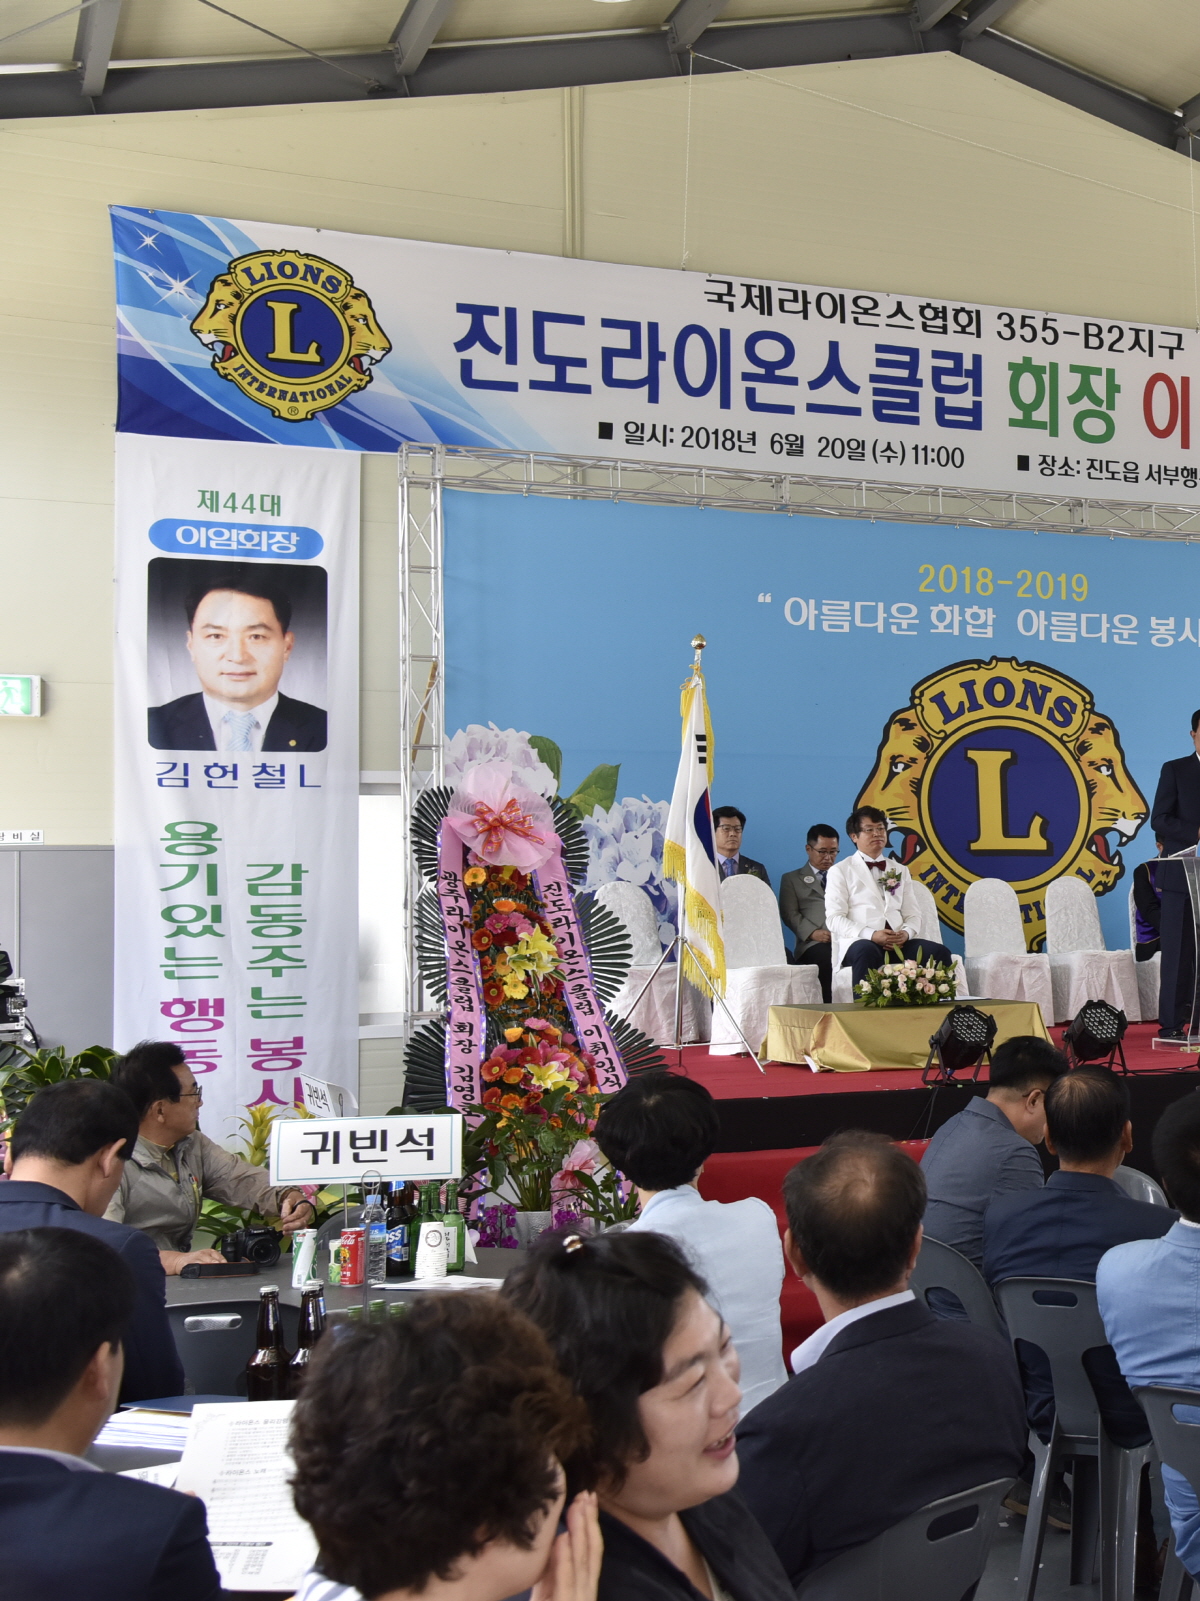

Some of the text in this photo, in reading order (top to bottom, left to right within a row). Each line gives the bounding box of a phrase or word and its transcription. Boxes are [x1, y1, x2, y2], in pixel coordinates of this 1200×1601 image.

[241, 260, 343, 294] LIONS
[265, 300, 323, 364] L
[703, 279, 1184, 360] 국제라이온스협회 355-B2지구
[233, 363, 353, 403] INTERNATIONAL
[454, 302, 983, 431] 진도라이온스클럽
[1008, 356, 1120, 444] 회장
[624, 421, 674, 447] 일시:
[681, 426, 756, 453] 2018년
[771, 433, 804, 457] 6월
[912, 444, 964, 469] 11:00
[1038, 455, 1080, 478] 장소:
[1086, 459, 1139, 483] 진도읍
[197, 490, 281, 517] 제44대
[176, 525, 300, 553] 이임회장
[919, 564, 1088, 602] 2018-2019
[784, 596, 919, 635] 아름다운
[930, 604, 996, 638] 화합
[1017, 608, 1139, 645] 아름다운
[929, 675, 1078, 730] LIONS
[964, 749, 1051, 855] L
[159, 821, 226, 980] 용기있는
[245, 863, 309, 1020] 감동주는
[440, 870, 475, 1013] 광주라이온스클럽
[543, 881, 623, 1089] 진도라이온스클럽 이취임식
[453, 1021, 478, 1055] 회장
[305, 1082, 330, 1112] 귀빈석
[301, 1128, 434, 1165] 귀빈석
